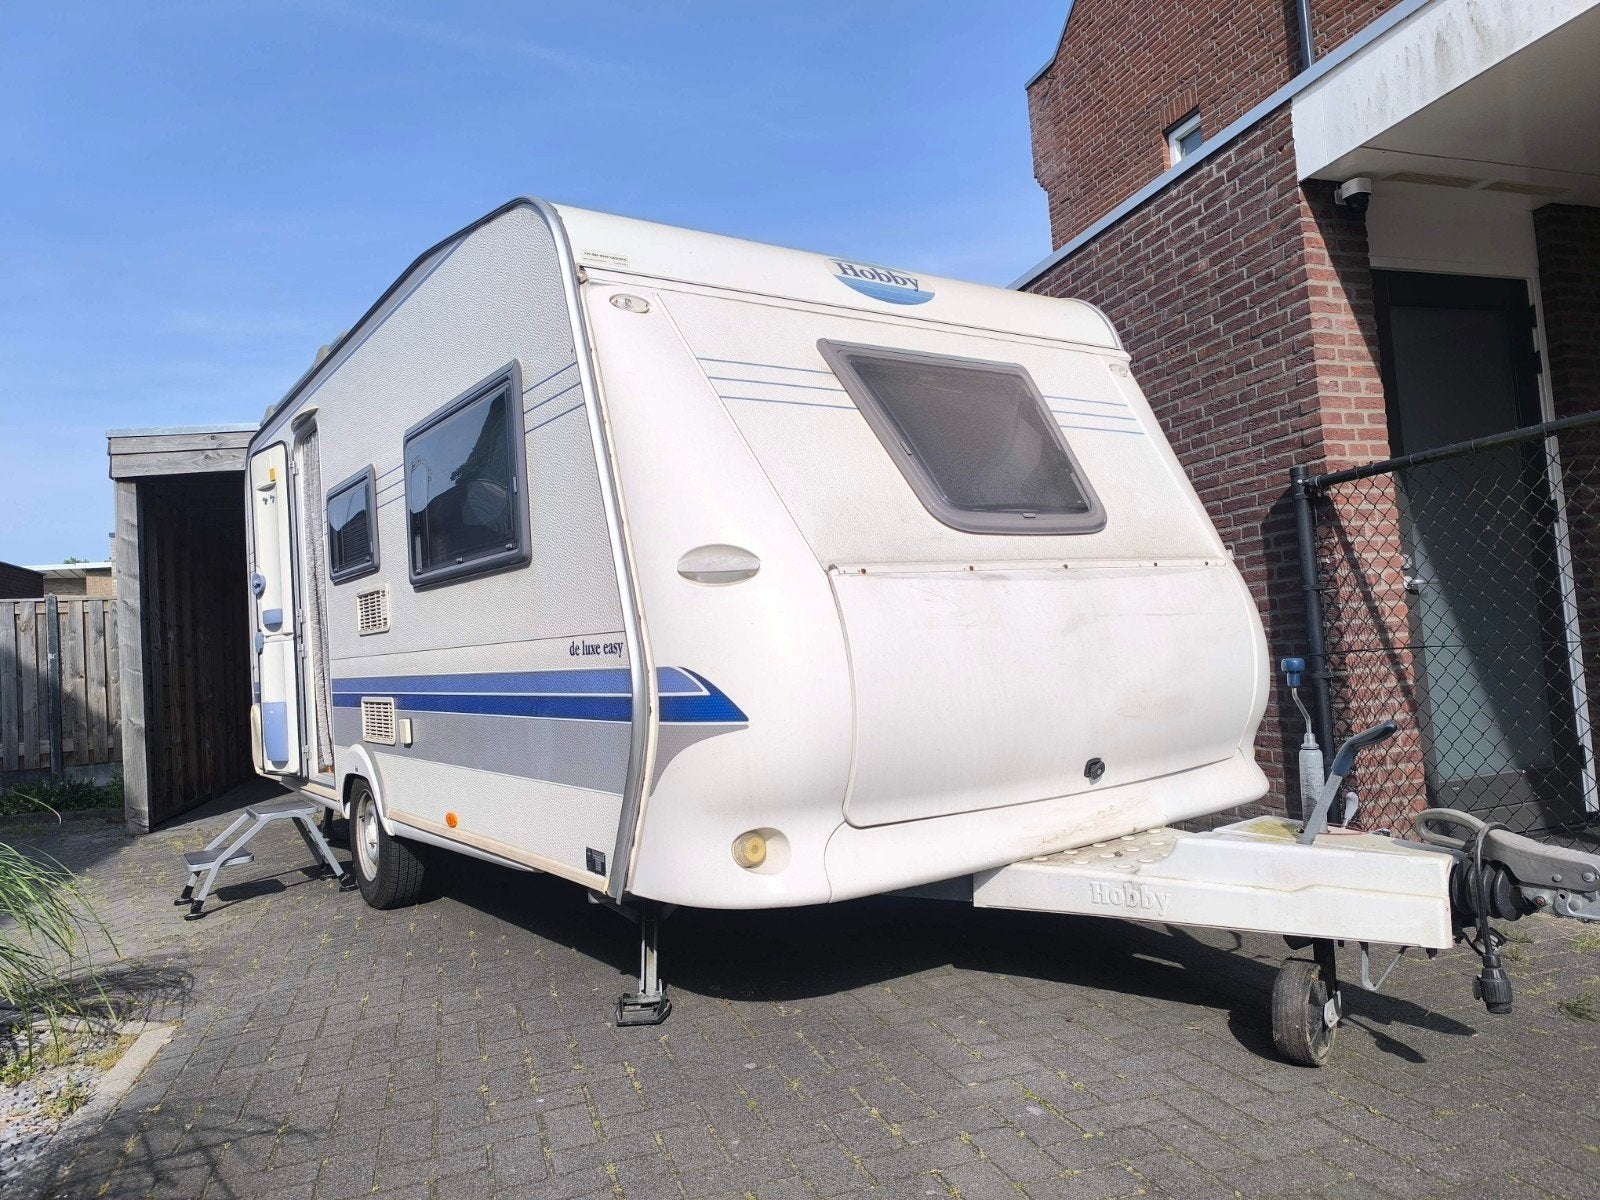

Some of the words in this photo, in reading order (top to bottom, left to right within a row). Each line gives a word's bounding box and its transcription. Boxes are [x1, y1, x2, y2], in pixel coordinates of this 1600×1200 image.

[833, 262, 919, 292] Hobby
[569, 641, 580, 656] de
[582, 641, 601, 656] luxe
[603, 643, 623, 658] easy
[1090, 881, 1172, 917] Hobby
